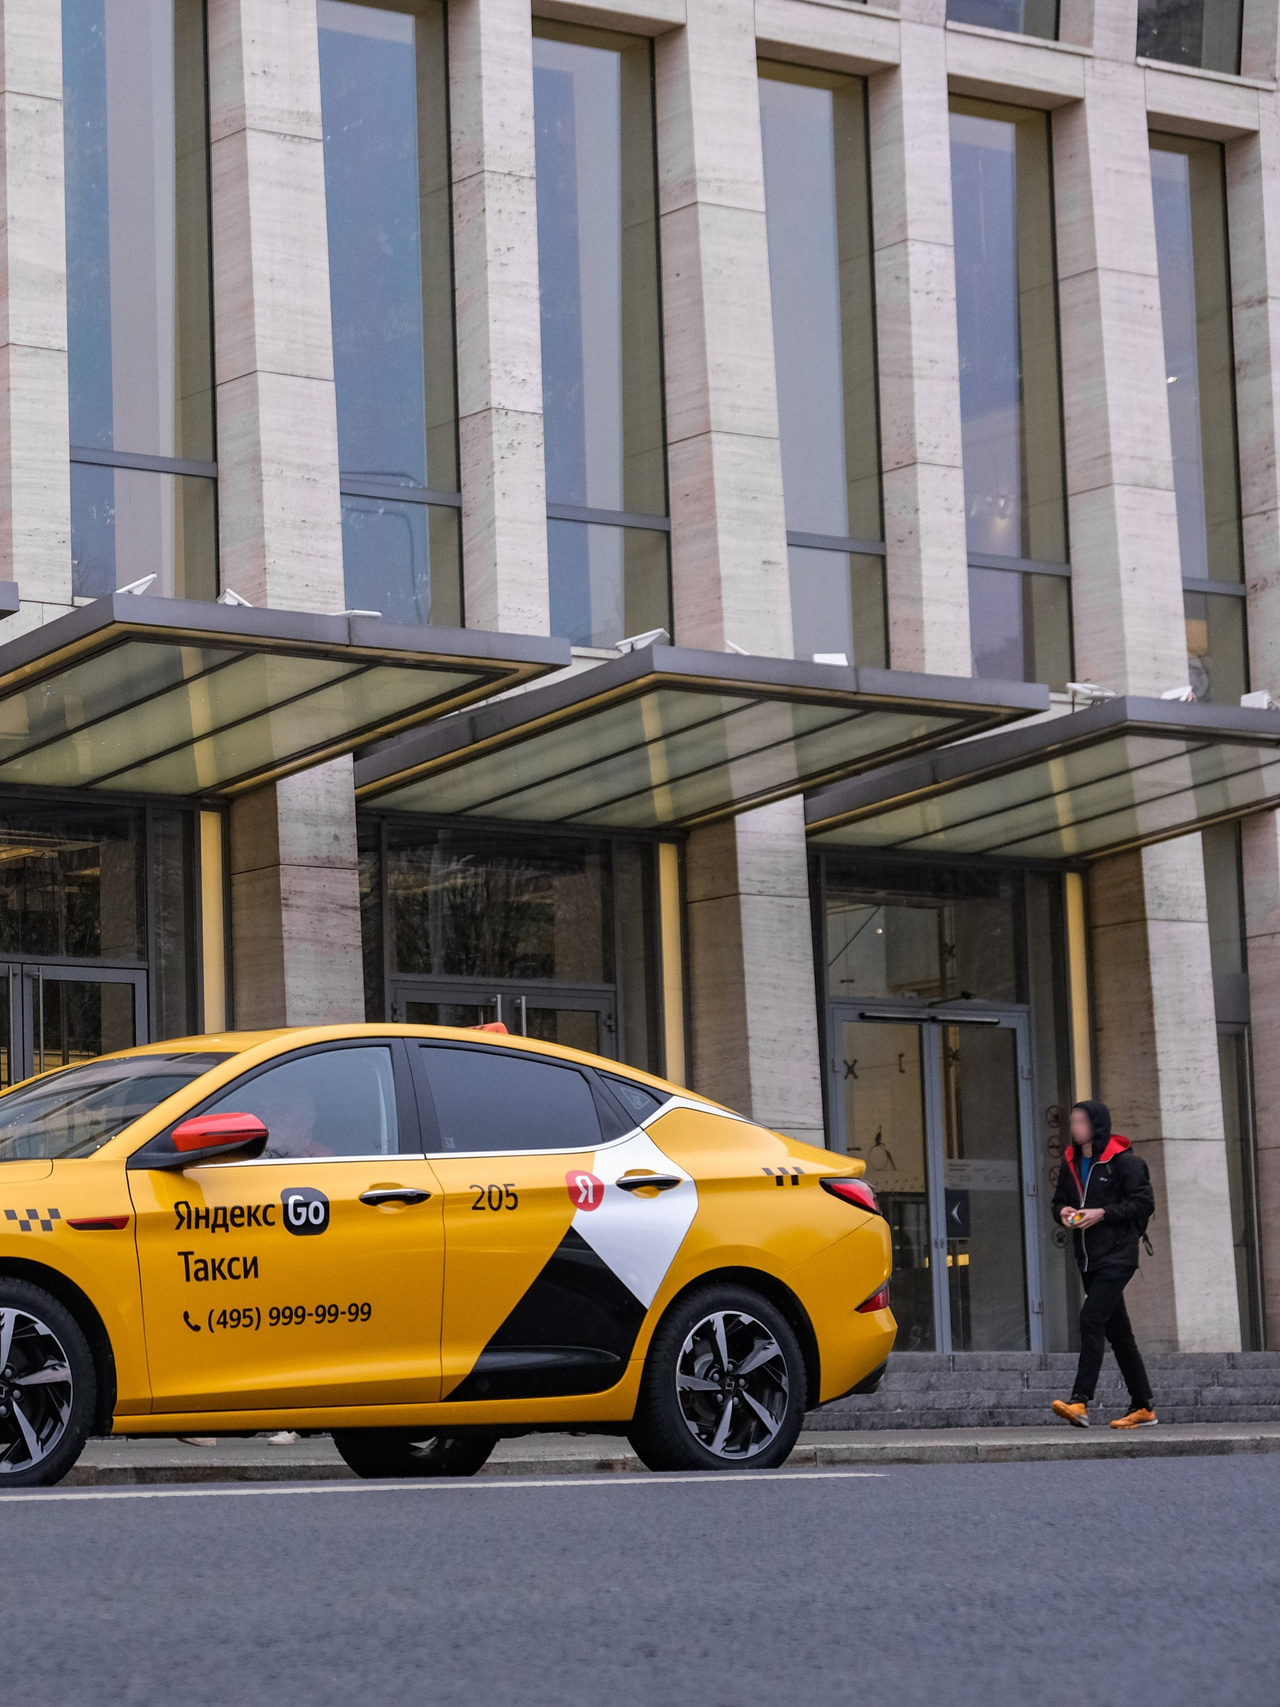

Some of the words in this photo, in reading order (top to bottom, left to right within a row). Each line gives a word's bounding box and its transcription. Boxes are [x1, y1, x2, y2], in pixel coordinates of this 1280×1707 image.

[469, 1183, 518, 1211] 205
[574, 1175, 594, 1203] Я
[174, 1201, 276, 1233] Яндекс
[288, 1195, 325, 1226] Go
[177, 1251, 259, 1282] Такси
[208, 1307, 261, 1333] (495)
[269, 1302, 372, 1326] 999-99-99
